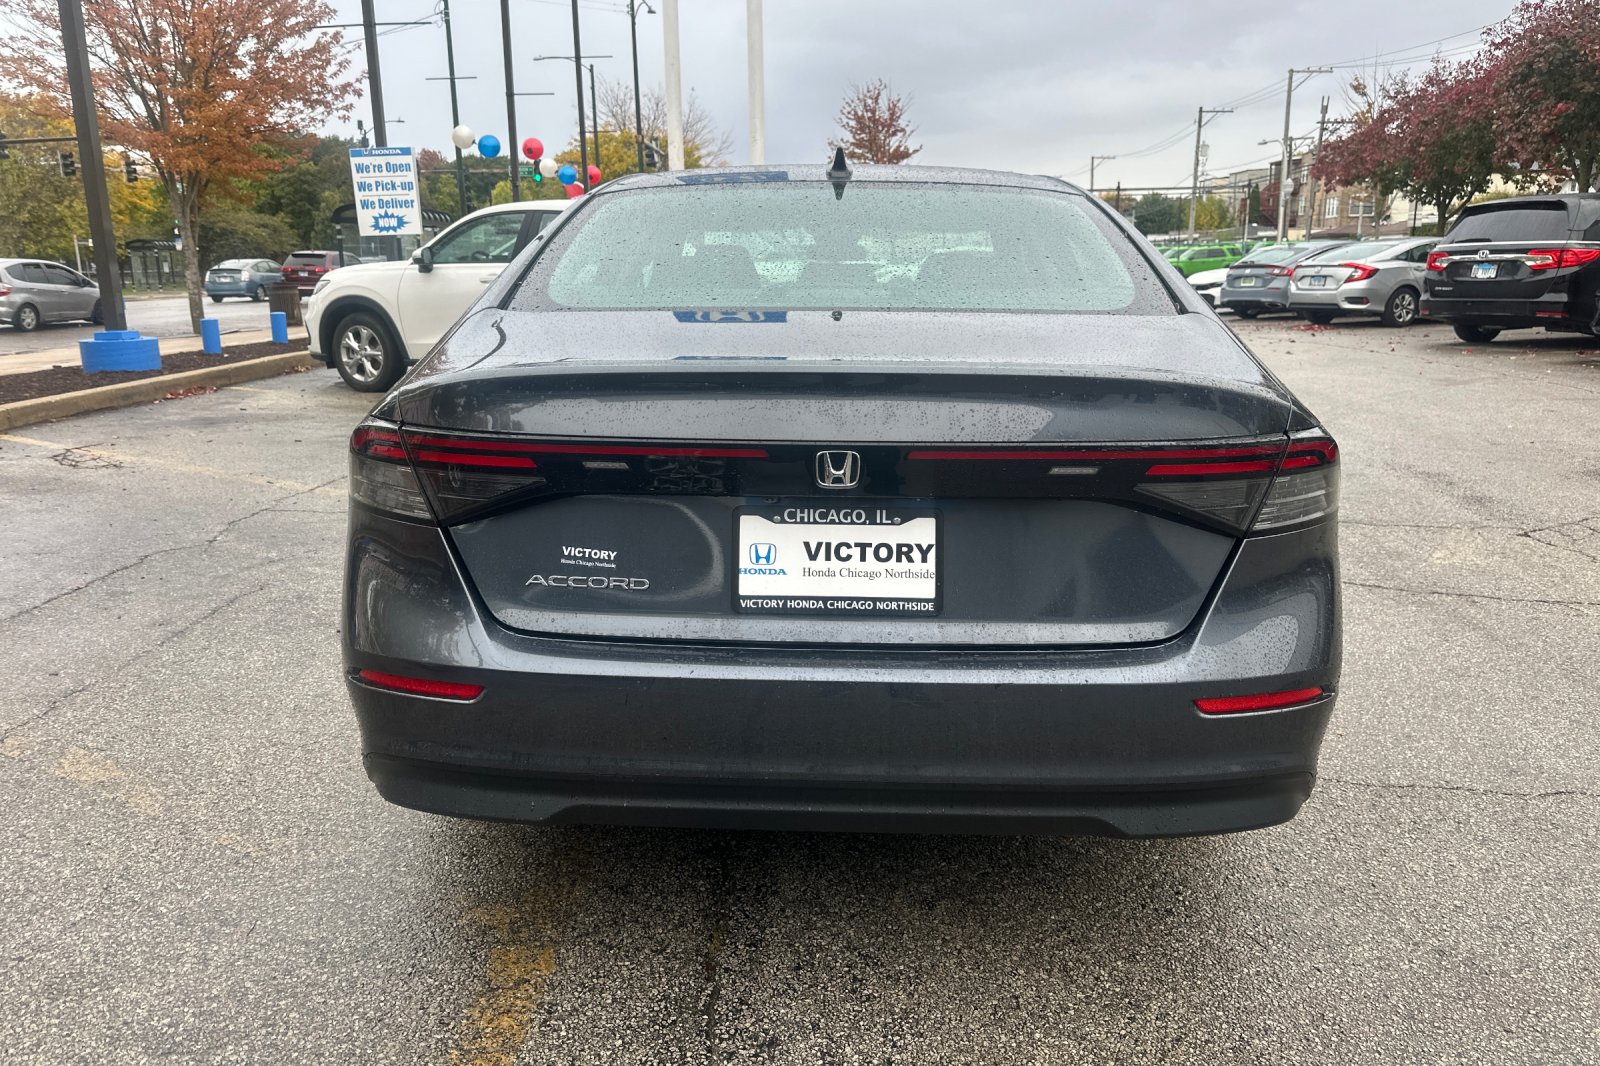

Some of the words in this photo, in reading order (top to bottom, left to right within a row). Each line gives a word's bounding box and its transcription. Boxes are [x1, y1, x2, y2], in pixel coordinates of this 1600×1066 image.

[355, 162, 383, 174] We're
[385, 161, 411, 174] Open
[357, 181, 373, 192] We
[375, 180, 414, 192] Pick-up
[360, 199, 376, 210] We
[378, 198, 415, 209] Deliver
[379, 217, 398, 227] NOW
[783, 508, 869, 524] CHICAGO,
[876, 509, 892, 524] IL
[562, 546, 618, 560] VICTORY
[803, 541, 935, 563] VICTORY
[576, 559, 594, 567] Chicago
[738, 567, 788, 576] HONDA
[802, 567, 836, 578] Honda
[839, 567, 882, 580] Chicago
[885, 568, 936, 579] Northside
[525, 574, 650, 590] ACCORD
[740, 599, 785, 608] VICTORY
[787, 599, 824, 609] HONDA
[827, 600, 873, 610] CHICAGO
[876, 601, 935, 611] NORTHSIDE
